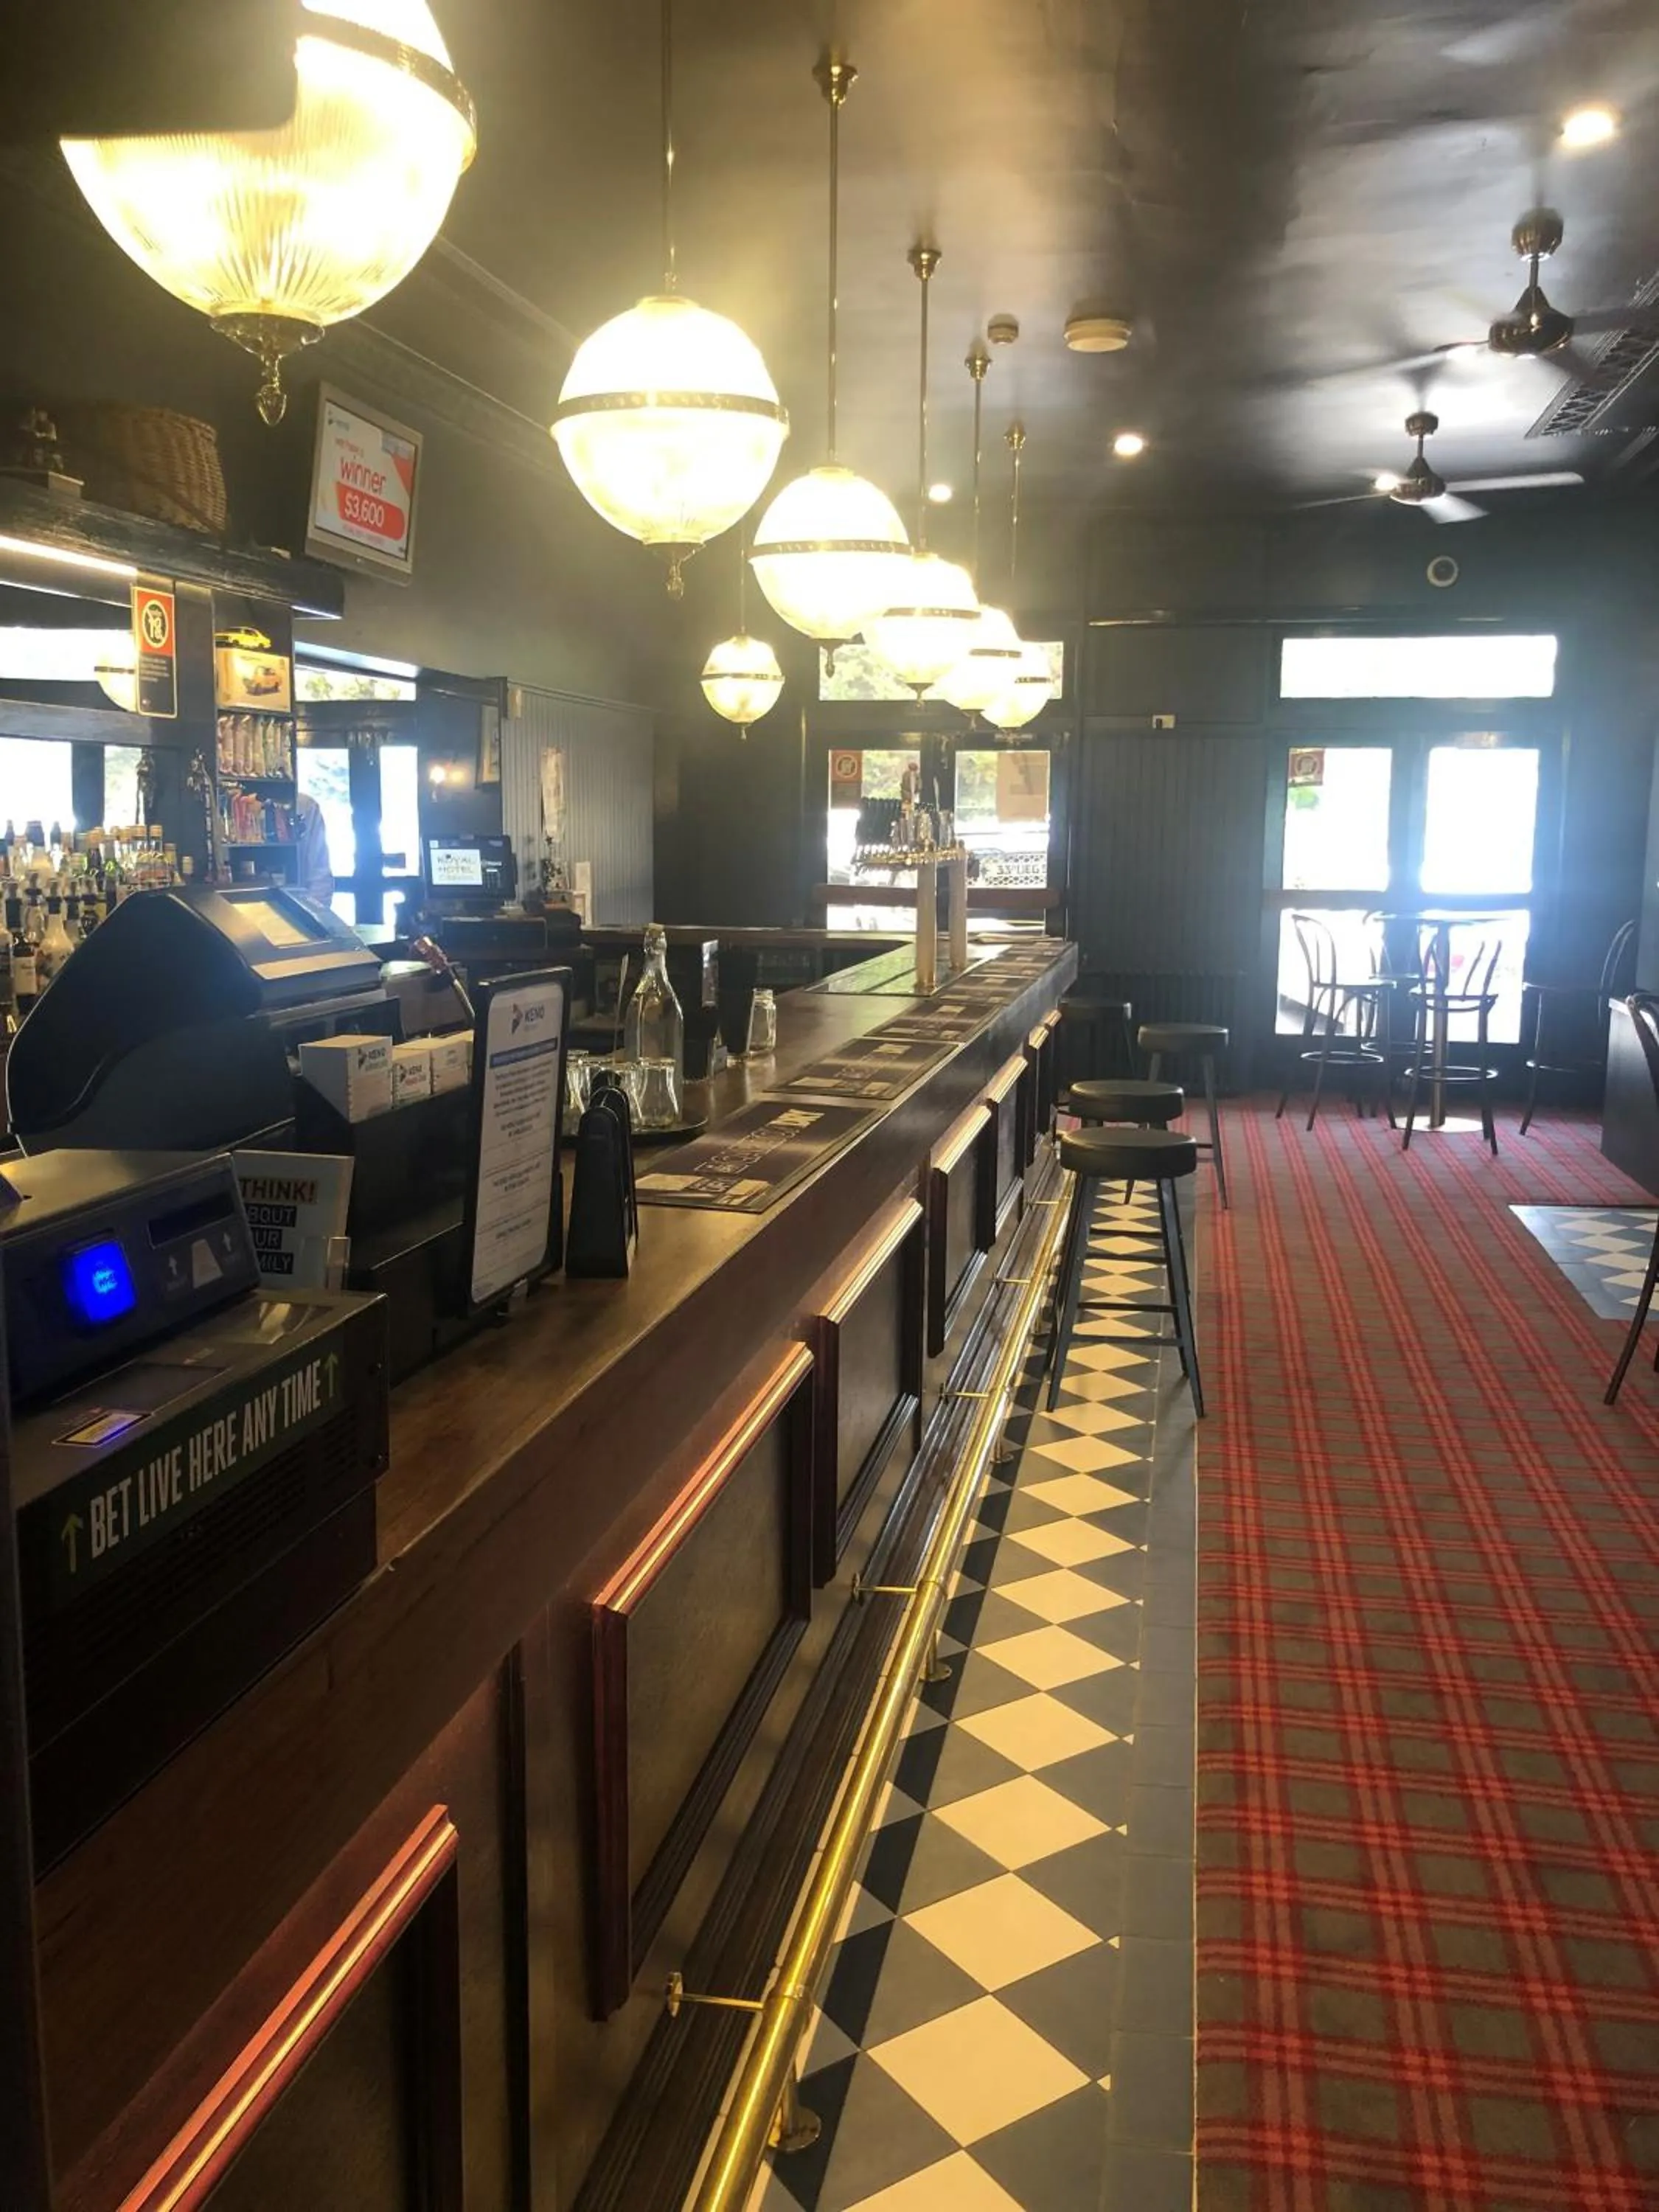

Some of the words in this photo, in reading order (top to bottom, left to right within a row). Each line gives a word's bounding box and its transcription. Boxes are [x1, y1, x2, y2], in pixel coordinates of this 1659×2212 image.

[340, 456, 386, 495] winner
[240, 1179, 316, 1203] THINK!
[247, 1206, 294, 1224] BOUT
[254, 1229, 279, 1247] UR
[90, 1477, 131, 1559] BET
[138, 1445, 183, 1527] LIVE
[189, 1411, 237, 1492] HERE
[242, 1385, 277, 1456] ANY
[281, 1358, 321, 1428] TIME
